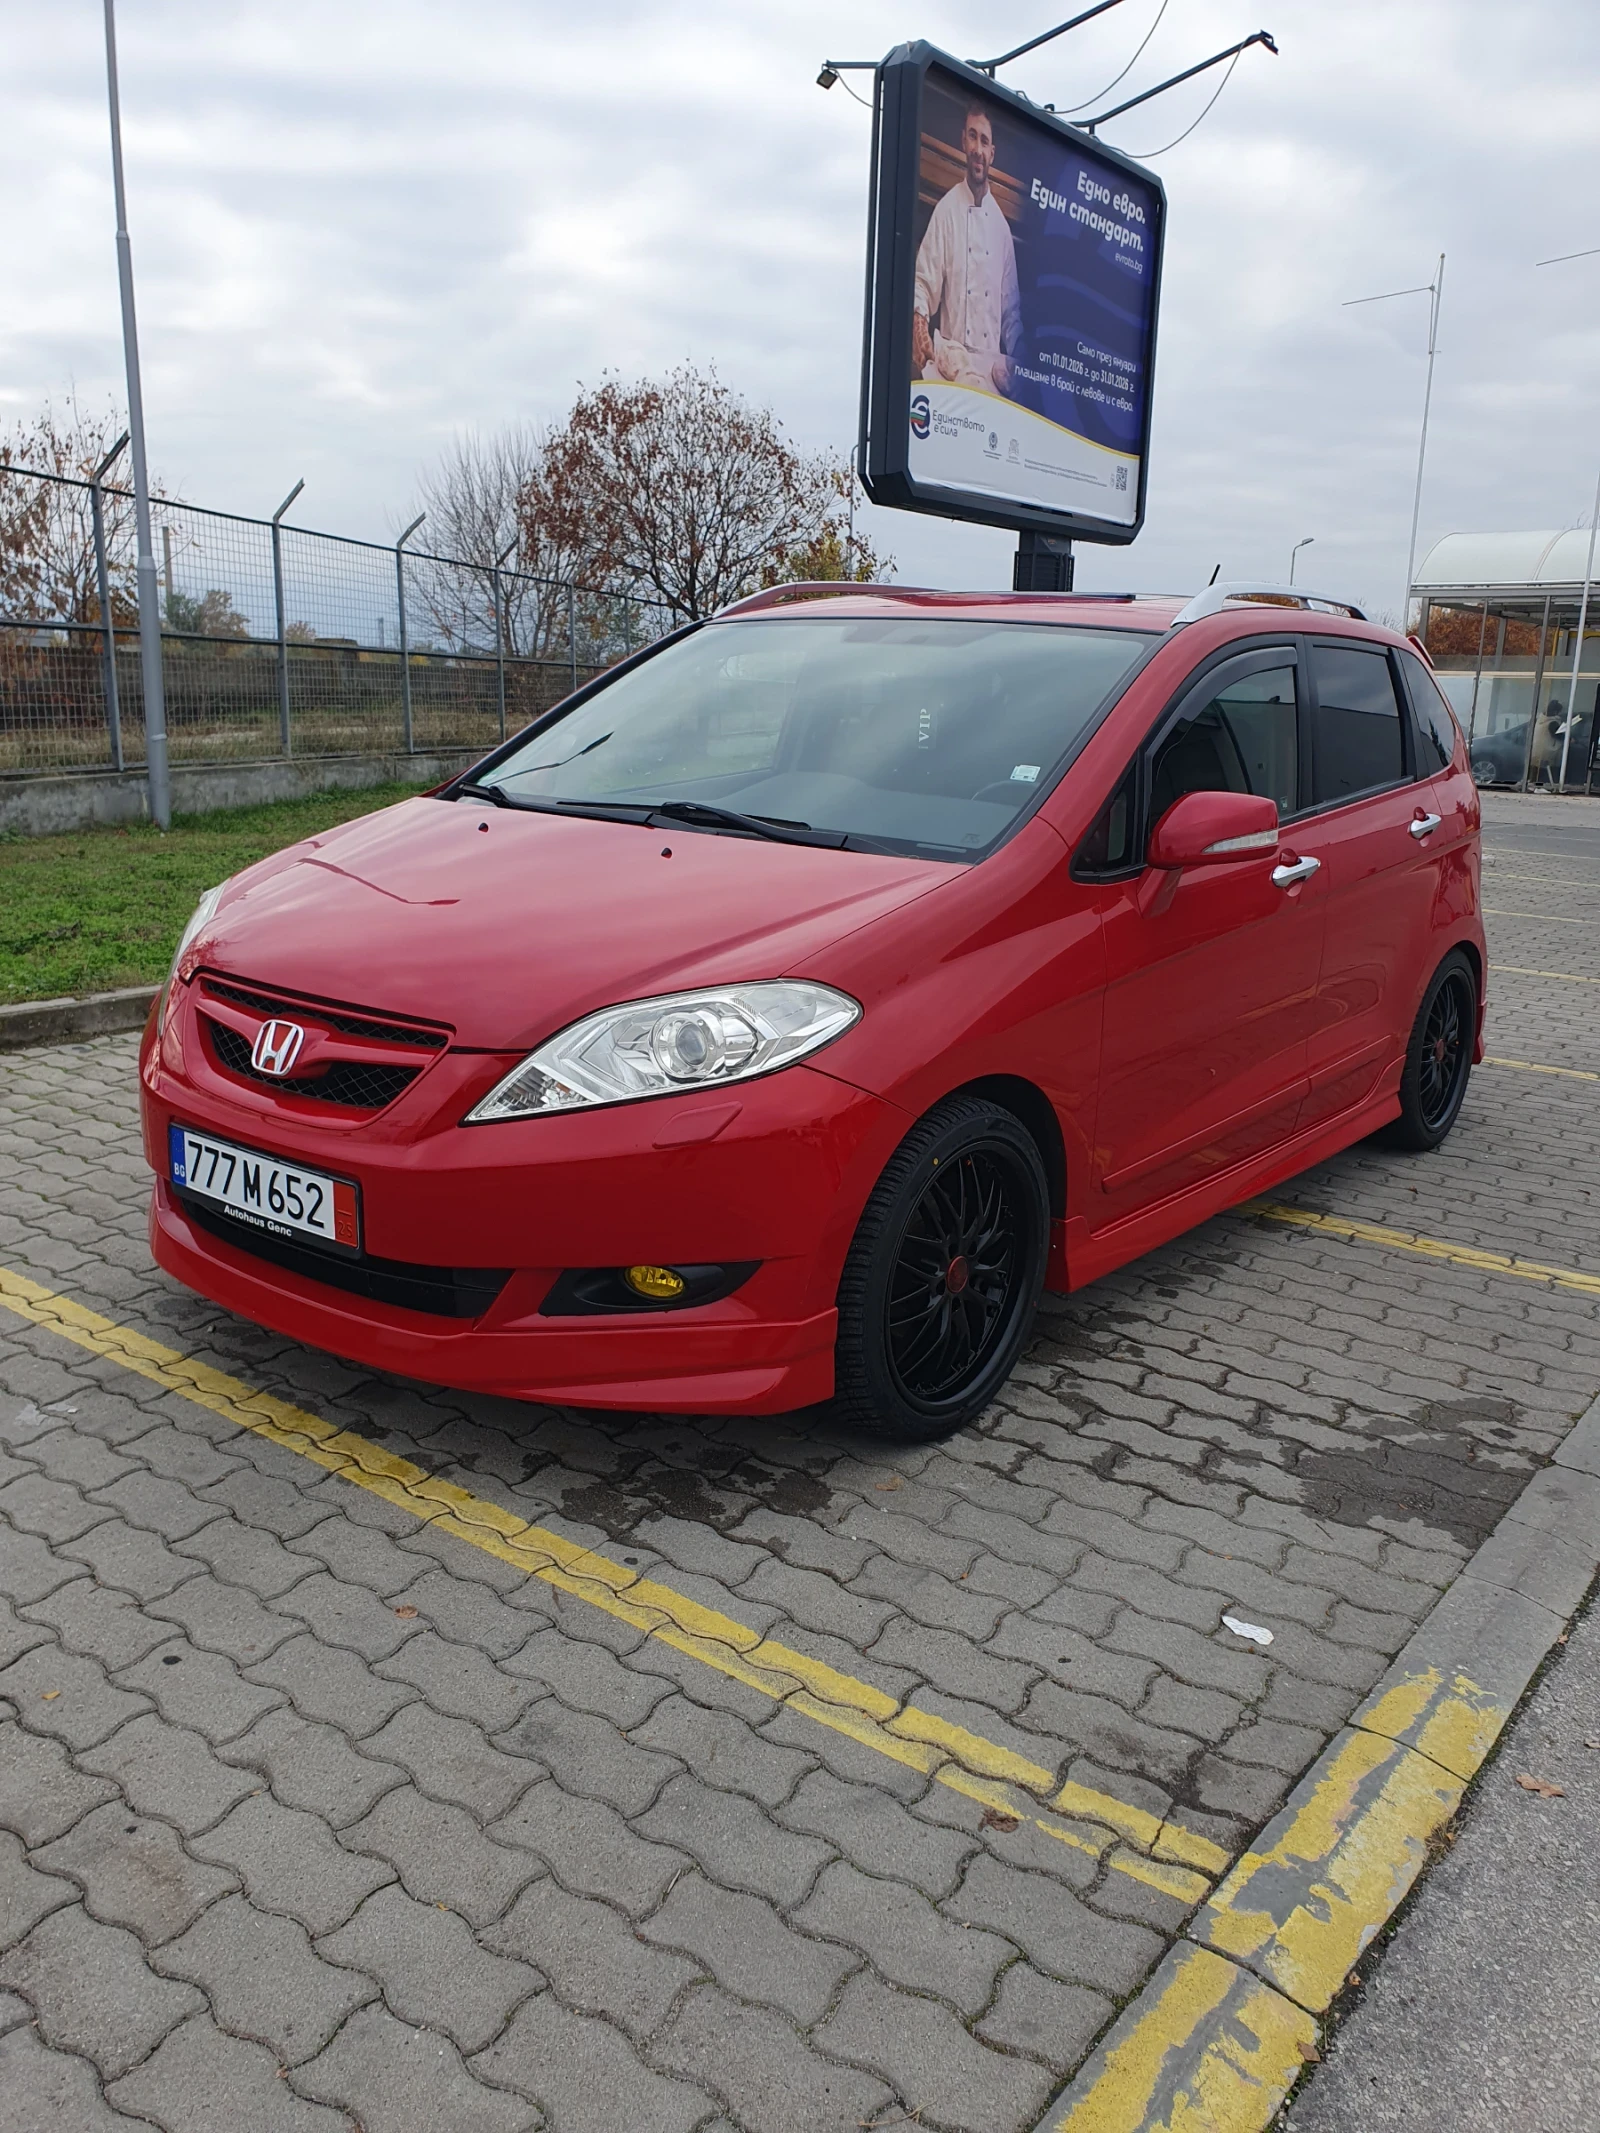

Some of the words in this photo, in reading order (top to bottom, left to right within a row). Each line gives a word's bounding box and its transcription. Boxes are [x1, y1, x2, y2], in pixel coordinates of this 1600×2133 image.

[1077, 170, 1111, 205] Едно
[1112, 193, 1146, 224] евро.
[1030, 178, 1067, 214] Един
[1069, 202, 1144, 252] стандарт.
[1115, 253, 1143, 274] evroto.bg
[1039, 351, 1052, 364] от
[1052, 353, 1084, 376] 01.01.2026
[1090, 370, 1100, 382] до
[1100, 369, 1129, 391] 31.01.2026
[1077, 341, 1096, 358] Само
[1096, 351, 1112, 367] през
[1112, 356, 1137, 373] януари
[1014, 365, 1050, 385] плащаме
[1050, 374, 1056, 387] в
[1056, 376, 1075, 393] брой
[1075, 385, 1080, 395] с
[1081, 387, 1105, 403] левове
[1105, 395, 1111, 405] и
[1111, 397, 1116, 406] с
[1116, 397, 1134, 412] евро.
[932, 409, 985, 433] Единството
[933, 424, 939, 433] е
[940, 425, 958, 437] сила
[918, 708, 930, 742] VIP
[174, 1162, 185, 1178] BG
[188, 1140, 236, 1195] 777
[243, 1159, 261, 1208] M
[268, 1170, 325, 1229] 652
[223, 1204, 265, 1228] Autohaus
[266, 1219, 292, 1237] Genc
